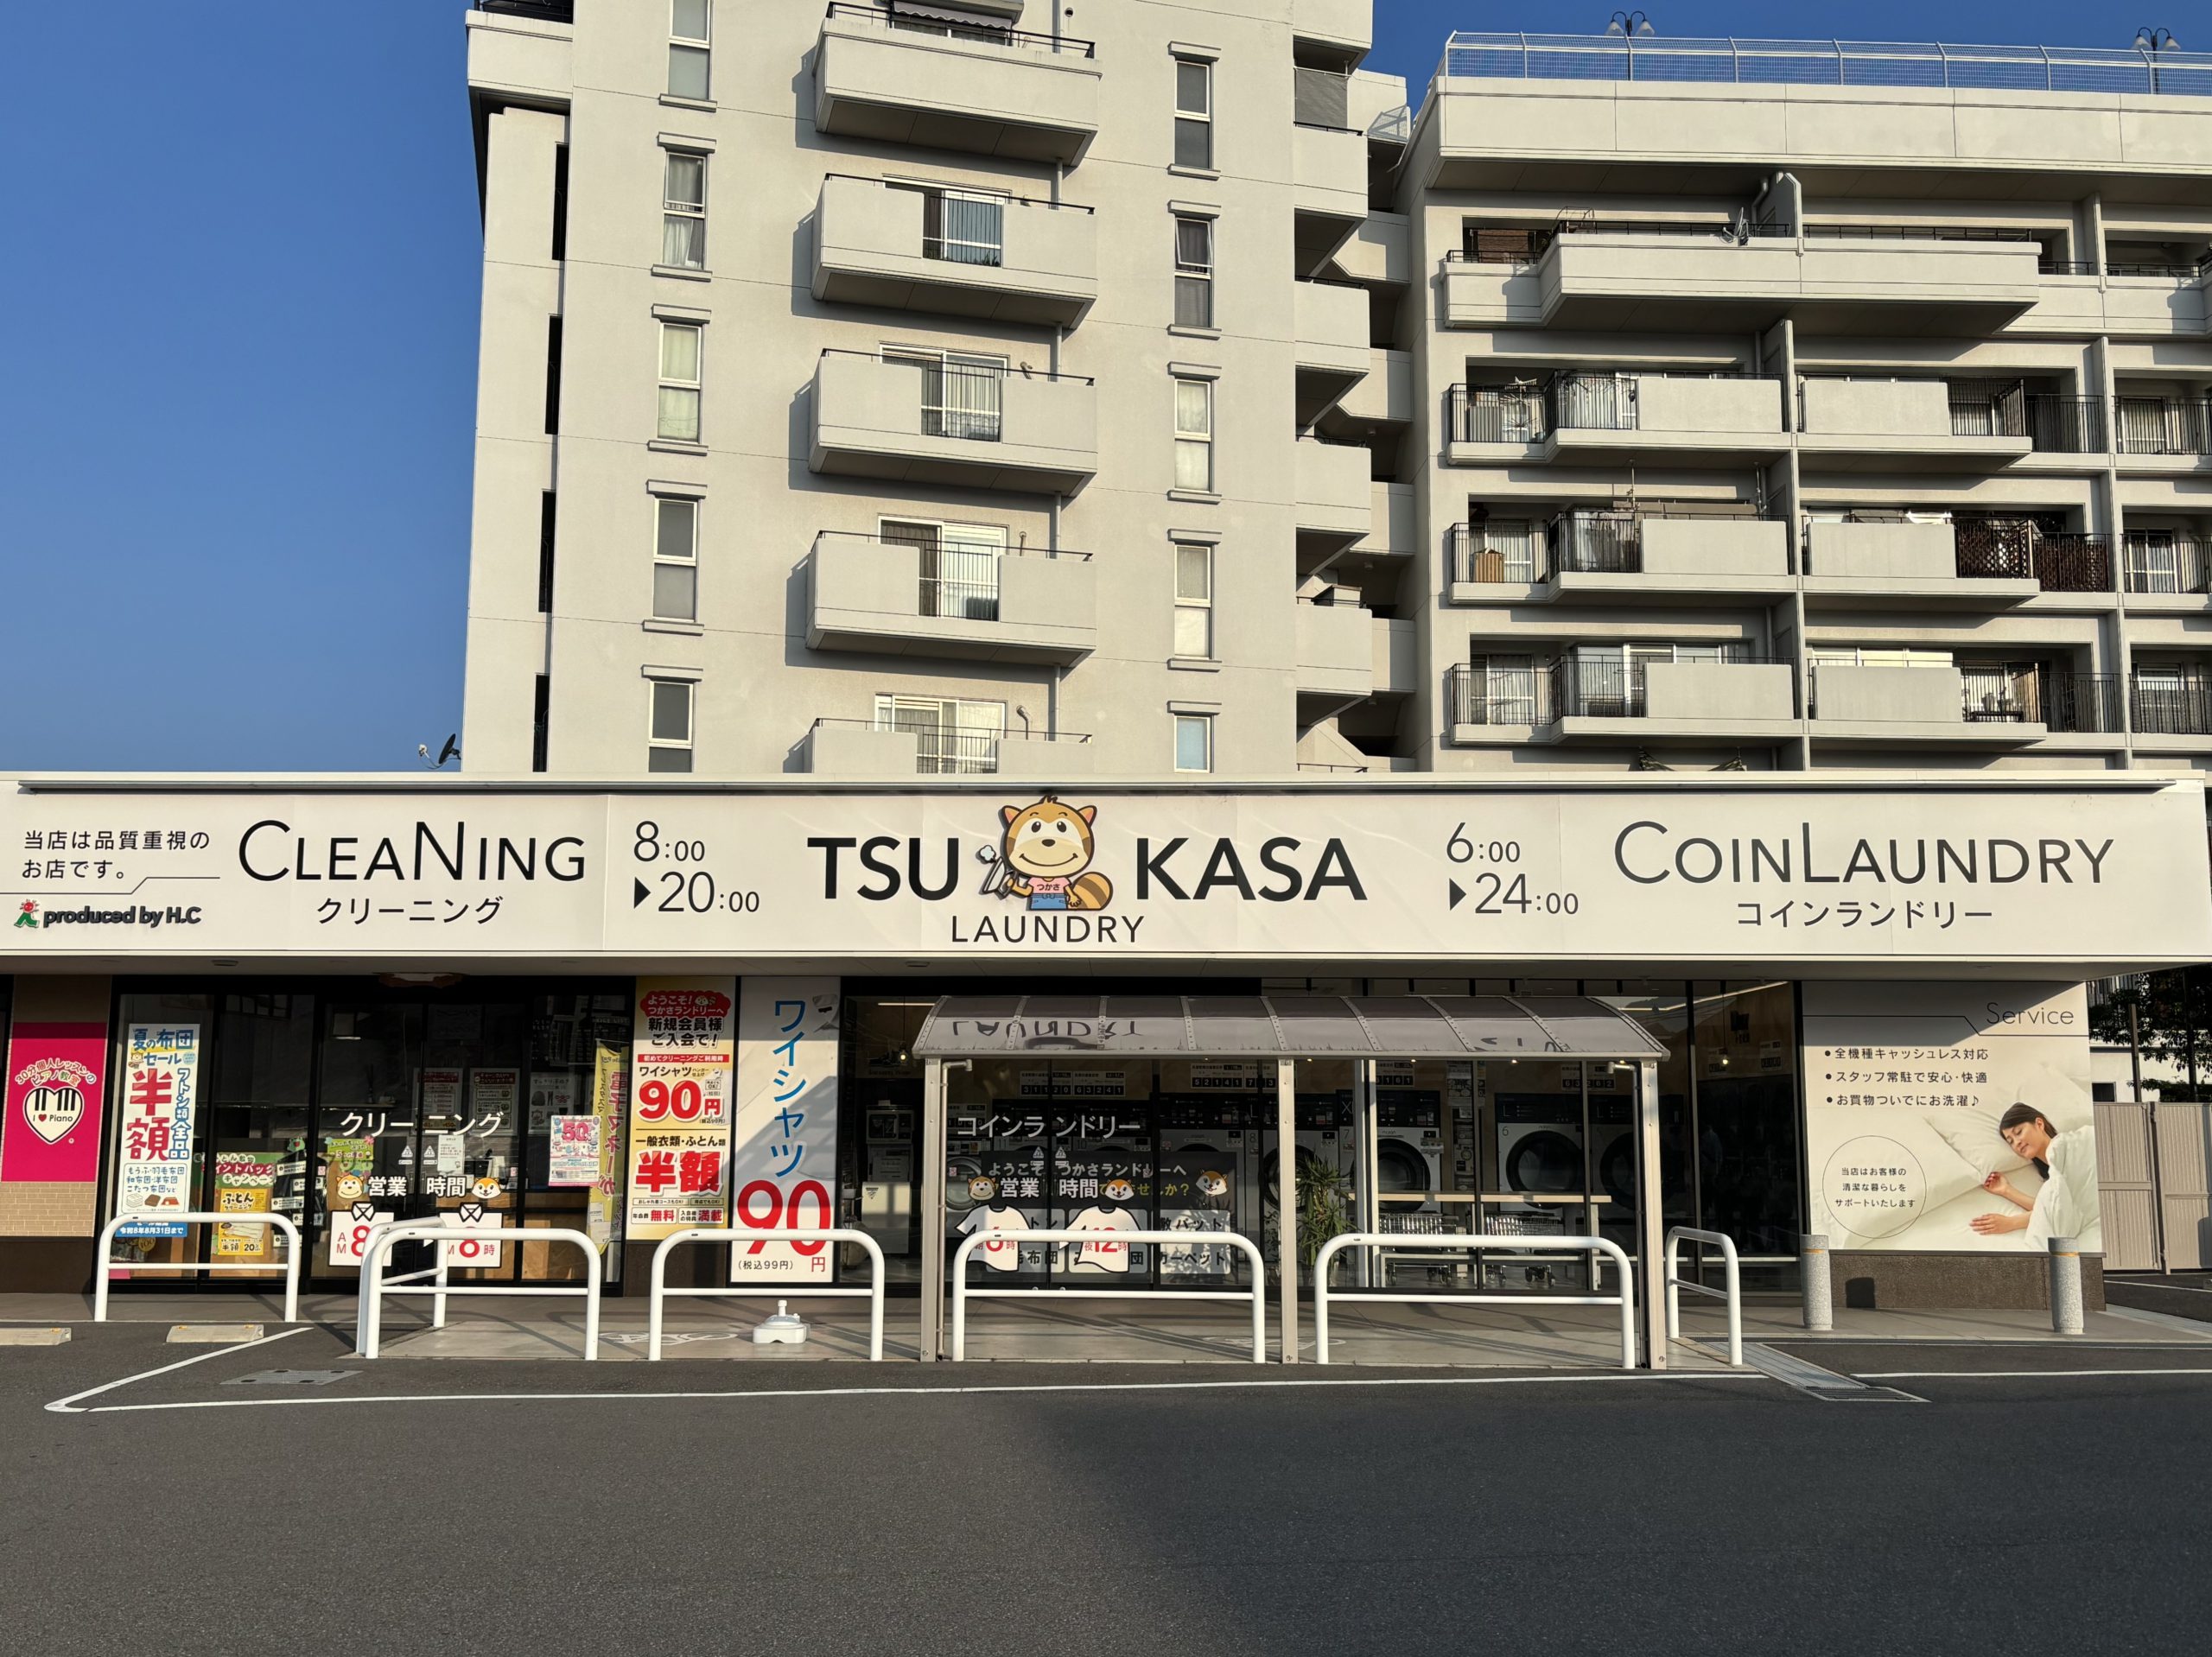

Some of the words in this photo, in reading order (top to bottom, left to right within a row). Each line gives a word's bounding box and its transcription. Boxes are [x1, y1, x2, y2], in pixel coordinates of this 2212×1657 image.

[23, 830, 210, 851] 当店は品質重視の
[634, 821, 706, 863] 8:00
[1446, 822, 1521, 864] 6:00
[22, 858, 128, 879] お店です。
[807, 835, 959, 901] TSU
[1136, 836, 1368, 902] KASA
[658, 871, 760, 913] 20:00
[1474, 873, 1580, 915] 24:00
[43, 906, 135, 927] produced
[138, 906, 163, 928] by
[316, 896, 505, 925] クリーニング
[1737, 900, 1993, 929] コインランドリー
[951, 915, 1145, 944] LAUNDRY
[648, 1006, 724, 1015] つかさランドリーへ
[1986, 1002, 2074, 1025] Service
[648, 1018, 722, 1031] 新規会員様
[133, 1029, 194, 1051] 夏の布団
[144, 1052, 182, 1066] セール
[1834, 1047, 1988, 1061] 全機種キャッシュレス対応
[16, 1058, 96, 1084] 30分個人レッスンの
[32, 1070, 81, 1087] ピアノ教室
[639, 1066, 692, 1077] ワイシャツ
[1835, 1070, 1987, 1084] スタッフ常駐で安心・快適
[770, 1000, 807, 1177] ワイシャツ
[49, 1114, 73, 1123] Piano
[125, 1069, 173, 1161] 半額
[170, 1068, 192, 1159] フトン類全品
[340, 1111, 505, 1138] クリーニング
[957, 1114, 1141, 1139] コインランドリー
[635, 1135, 727, 1147] 一般衣類・ふとん類
[636, 1151, 721, 1193] 半額
[1840, 1166, 1907, 1177] 当店はお客様の
[368, 1176, 407, 1197] 営業
[427, 1177, 467, 1197] 時間
[1000, 1178, 1039, 1198] 営業
[1058, 1178, 1098, 1199] 時間
[1841, 1183, 1907, 1193] 清潔な暮らしを
[223, 1192, 254, 1204] ふとん
[1834, 1197, 1916, 1209] サポートいたします
[651, 1209, 674, 1222] 無料
[737, 1179, 831, 1256] 90
[738, 1260, 793, 1271] (税込99円)
[811, 1257, 826, 1272] 円
